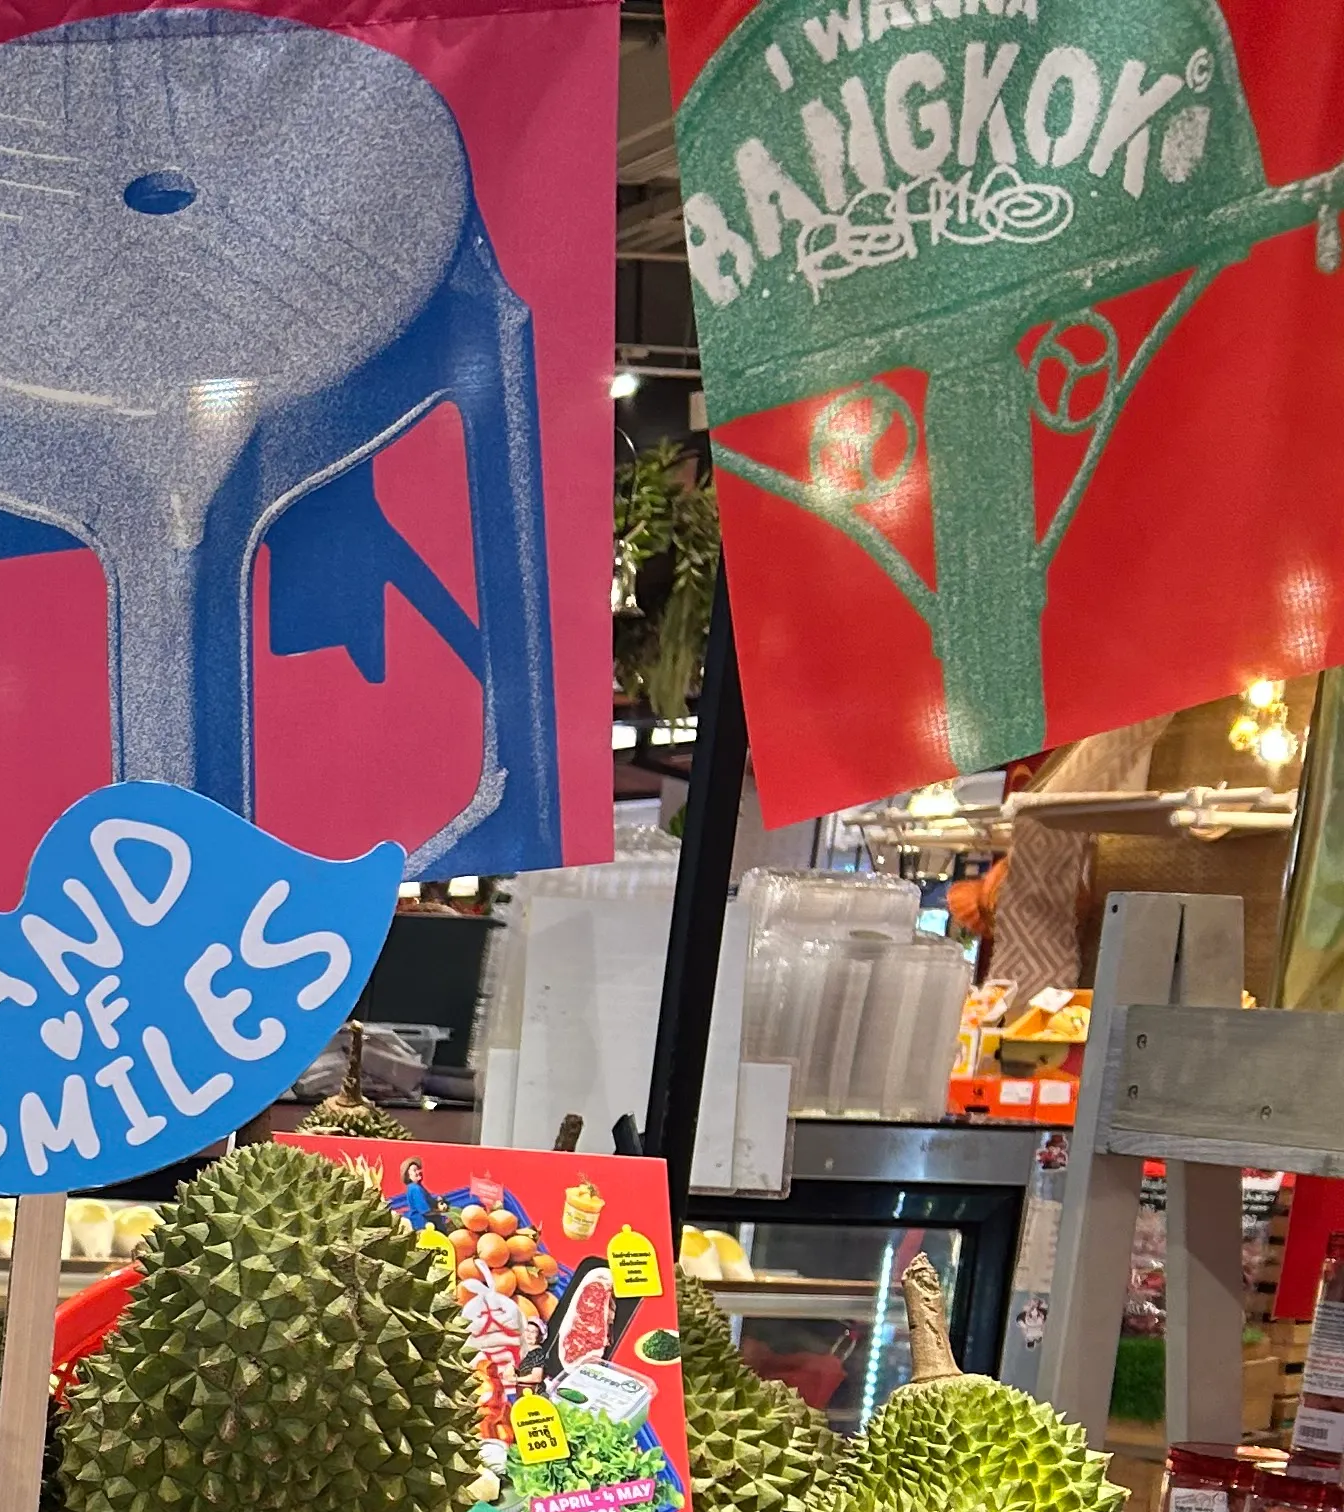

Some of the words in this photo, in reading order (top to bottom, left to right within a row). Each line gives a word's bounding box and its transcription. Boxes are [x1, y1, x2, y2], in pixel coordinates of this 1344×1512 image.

[527, 1440, 547, 1451] 100
[549, 1493, 594, 1512] APRIL
[603, 1491, 615, 1504] 4
[617, 1483, 652, 1501] MAY
